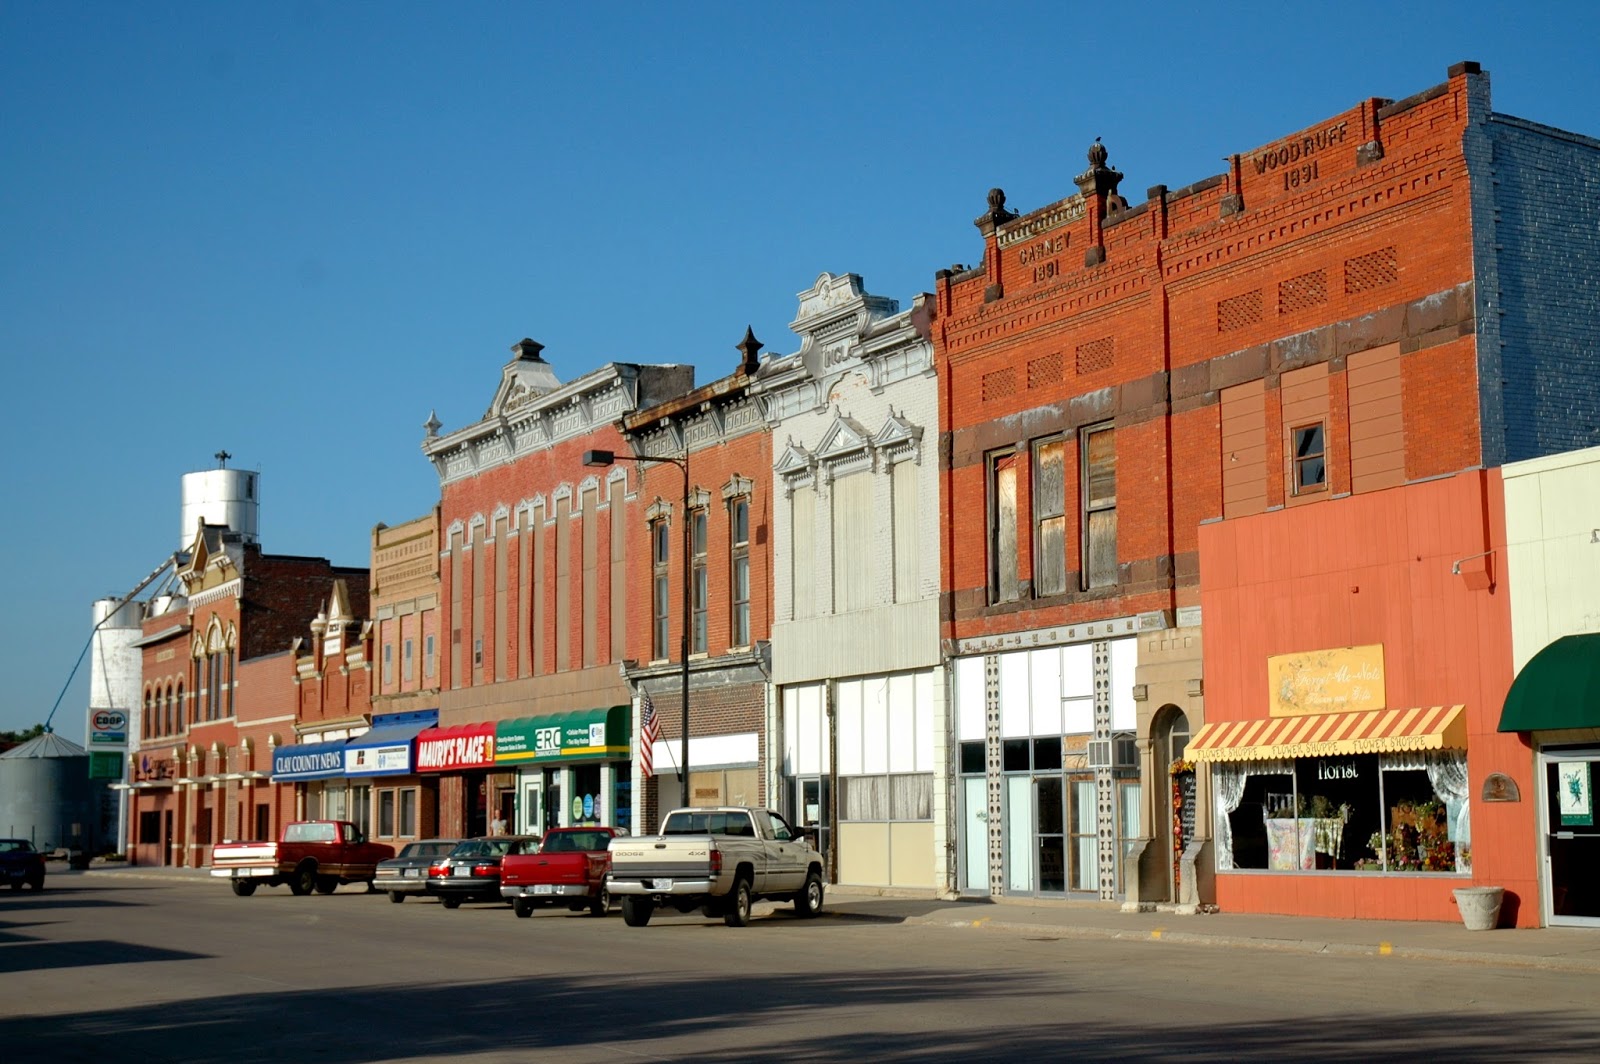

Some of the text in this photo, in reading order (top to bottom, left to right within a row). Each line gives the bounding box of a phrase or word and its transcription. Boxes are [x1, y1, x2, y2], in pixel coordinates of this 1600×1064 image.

[1253, 121, 1348, 175] WOODRUFF
[1284, 160, 1318, 191] 1891
[1019, 231, 1071, 266] CARNEY
[1033, 259, 1060, 283] 1891
[417, 738, 456, 768] MAURY'S
[455, 735, 485, 764] PLACE
[1197, 746, 1257, 759] FLOWER SHOPPE
[1271, 741, 1338, 755] FLOWER SHOPPE
[1353, 736, 1425, 750] FLOWER SHOPPE
[276, 751, 341, 773] CLAY COUNTY NEWS
[1318, 760, 1359, 780] florist
